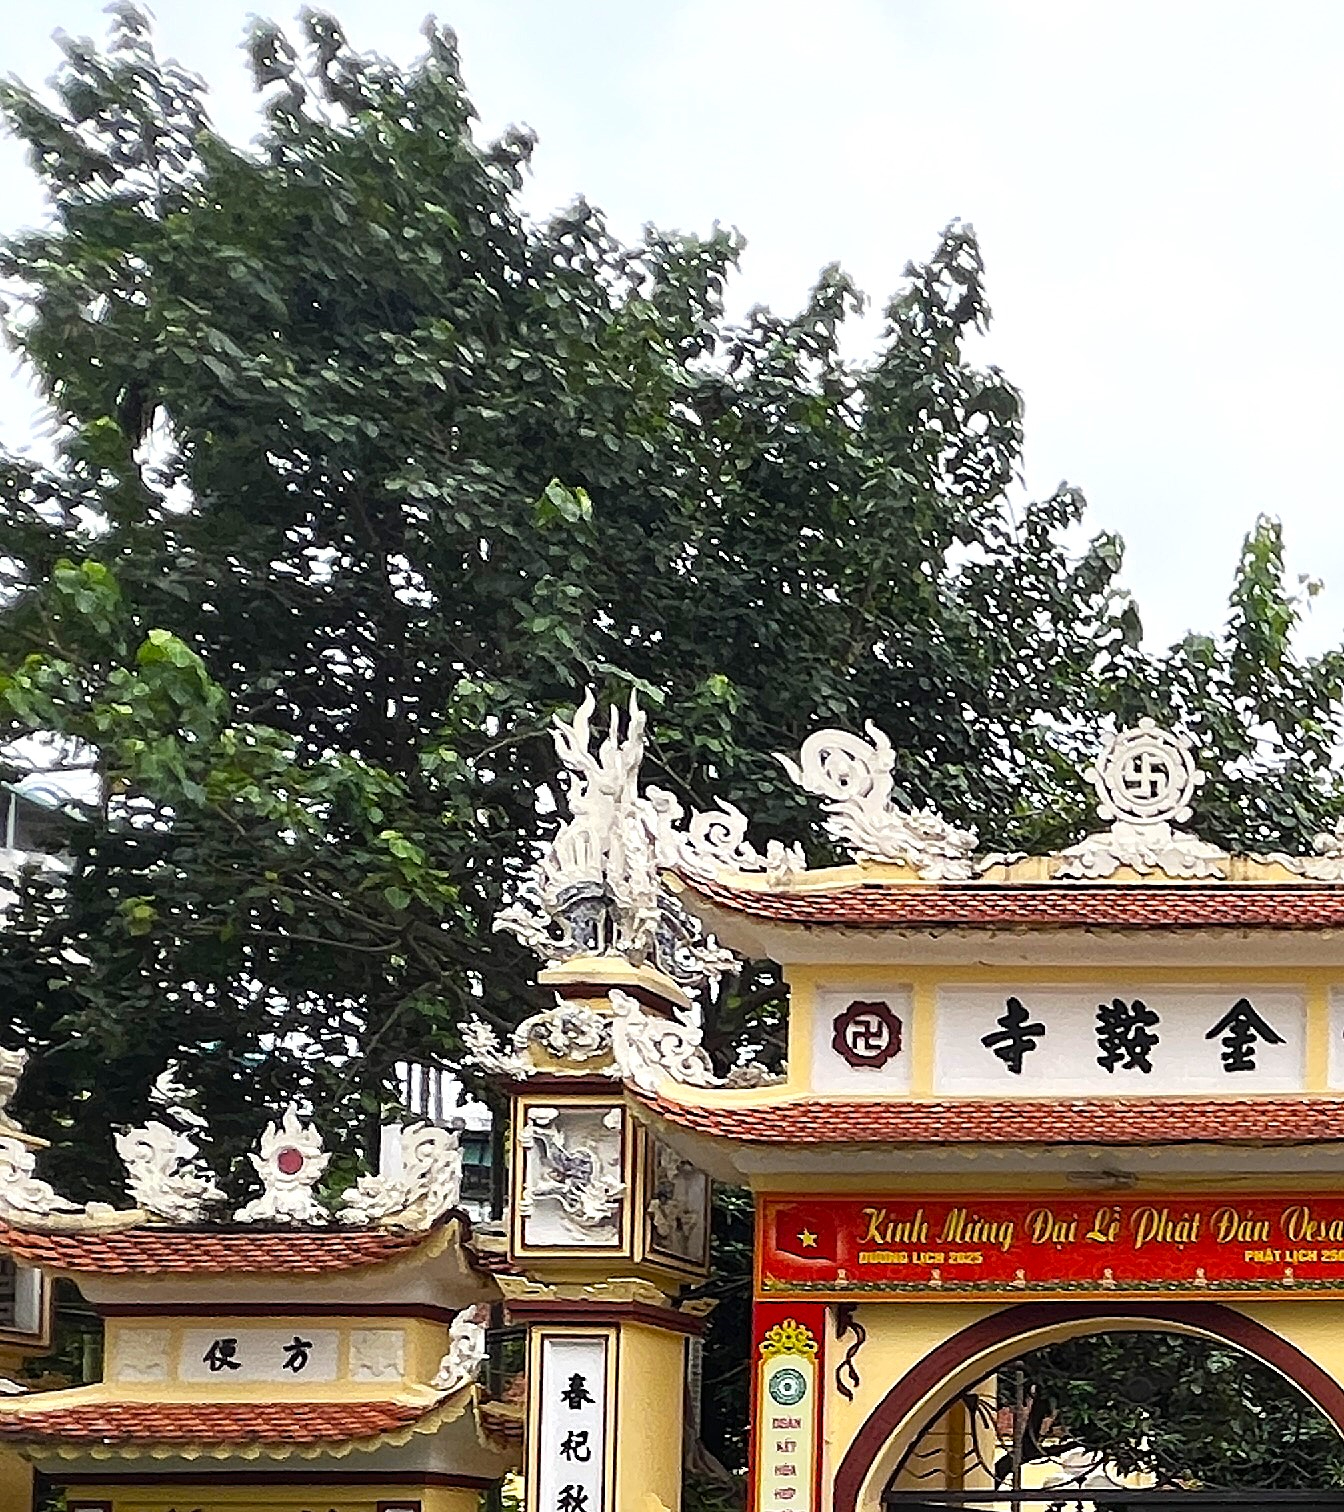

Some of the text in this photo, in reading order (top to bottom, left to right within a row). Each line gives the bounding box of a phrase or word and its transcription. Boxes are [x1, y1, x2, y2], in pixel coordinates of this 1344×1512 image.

[857, 1208, 929, 1244] Kính
[935, 1208, 1014, 1252] Mừng
[1024, 1208, 1078, 1250] Đại
[1084, 1205, 1121, 1243] Lễ
[1131, 1206, 1201, 1250] Phật
[1210, 1206, 1270, 1244] Đản
[948, 1251, 984, 1265] 2025
